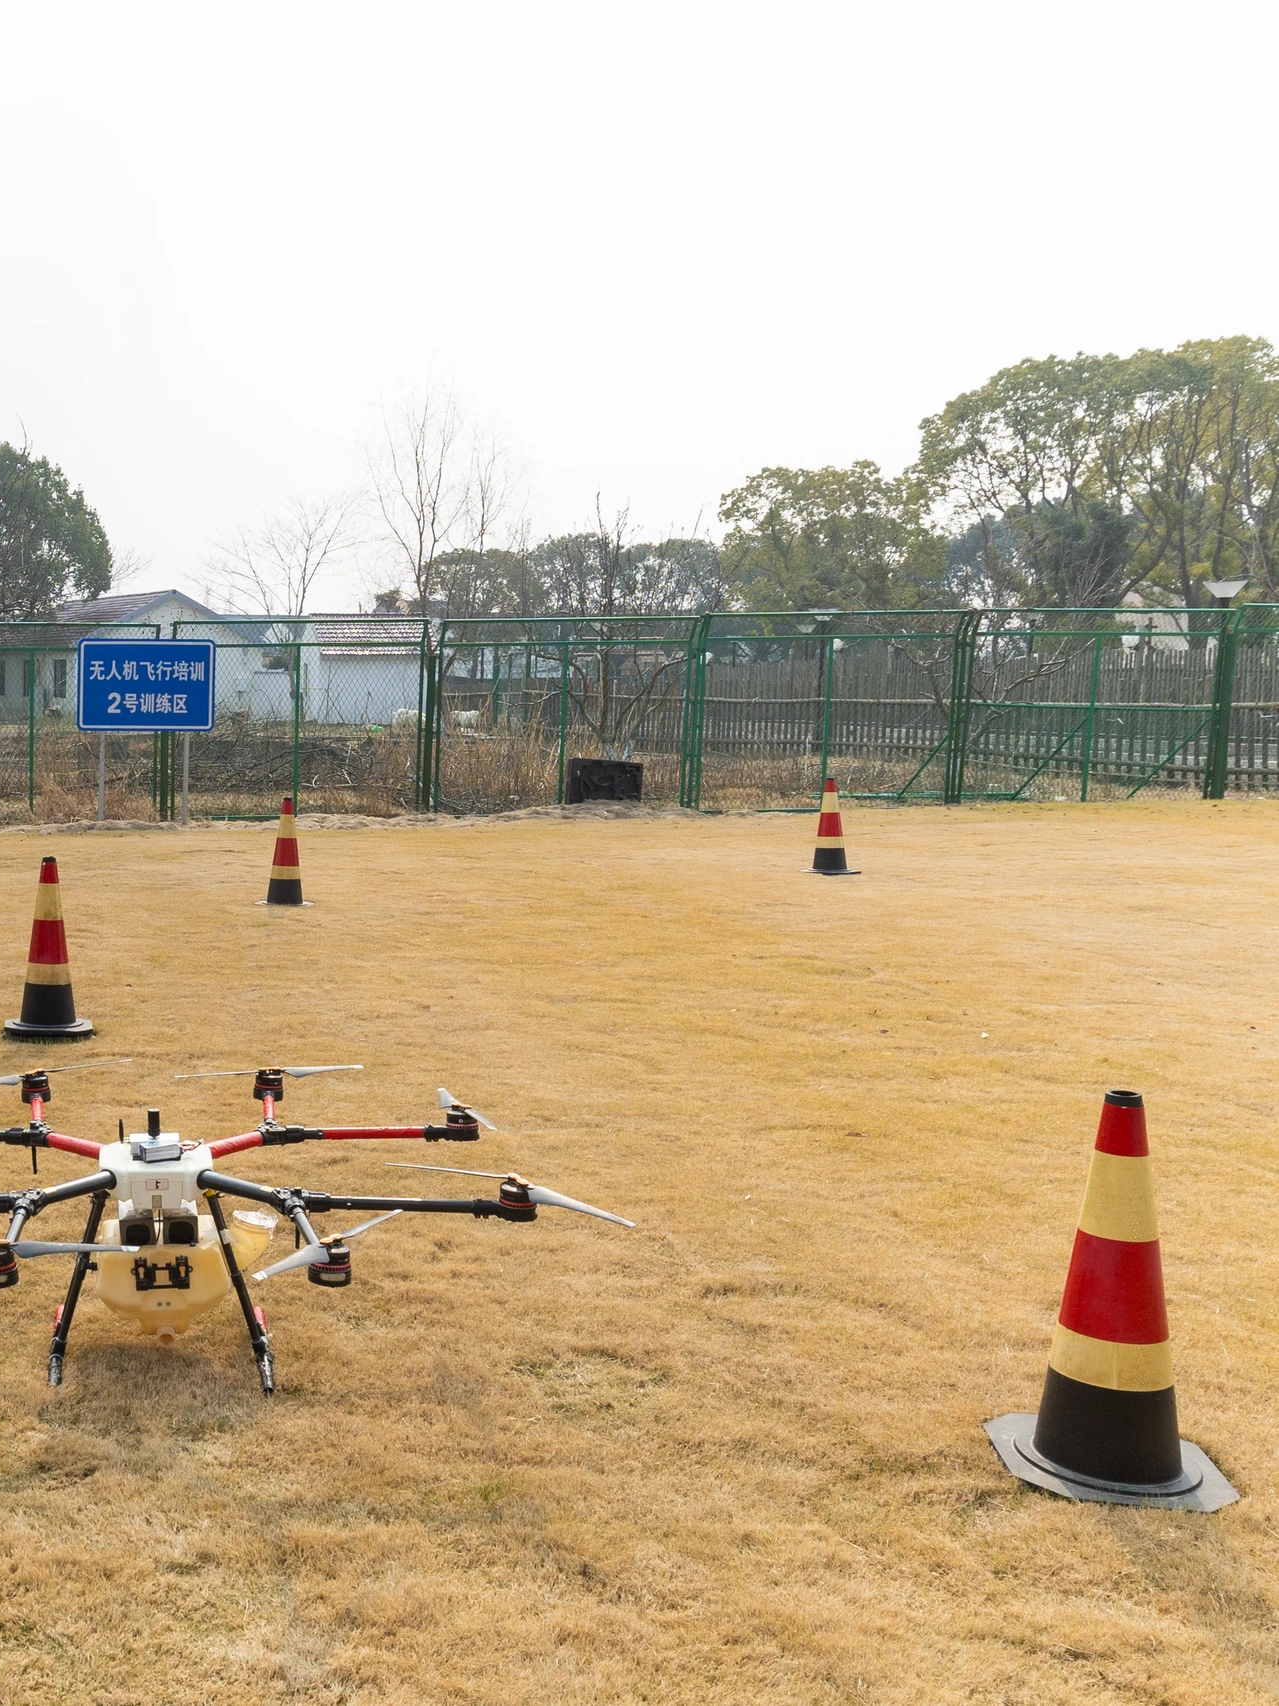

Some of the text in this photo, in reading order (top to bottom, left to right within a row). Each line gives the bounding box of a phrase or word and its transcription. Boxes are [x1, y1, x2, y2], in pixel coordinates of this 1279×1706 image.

[89, 660, 205, 682] 无人机飞行培训
[107, 692, 188, 714] 2号训练区
